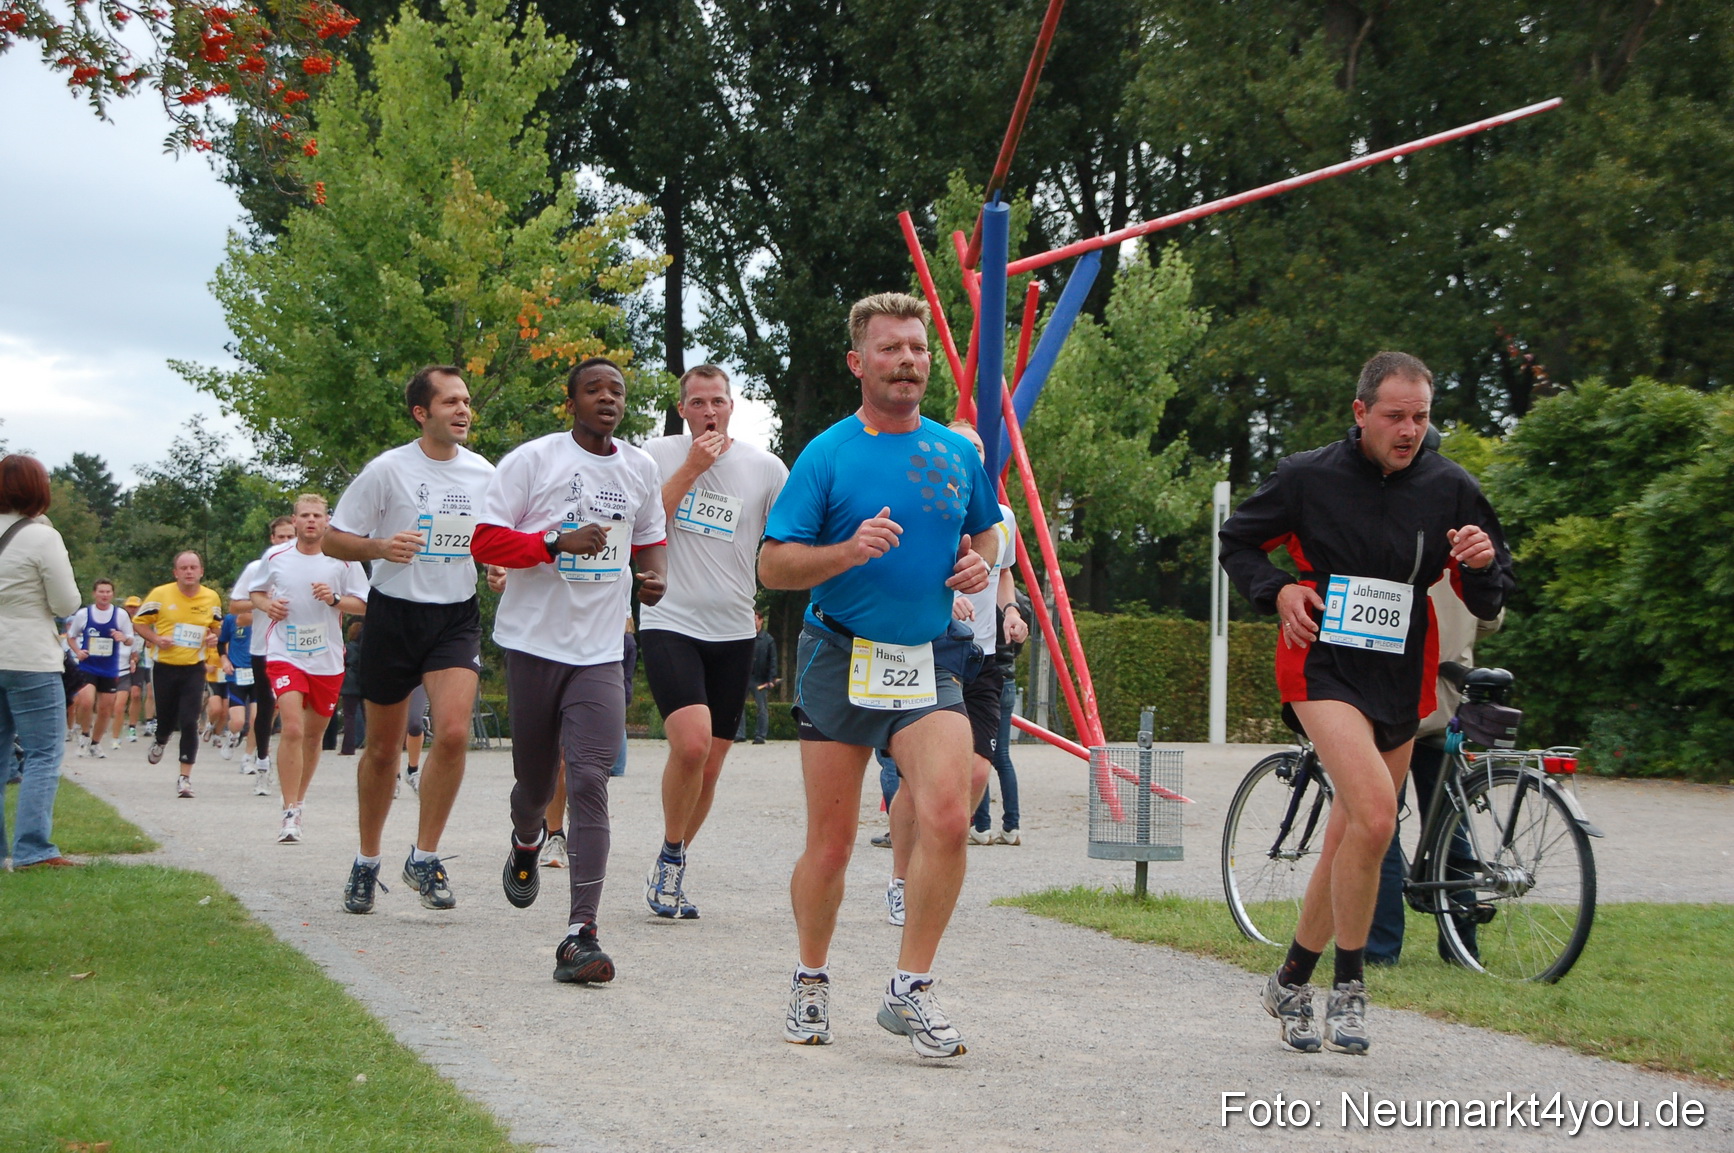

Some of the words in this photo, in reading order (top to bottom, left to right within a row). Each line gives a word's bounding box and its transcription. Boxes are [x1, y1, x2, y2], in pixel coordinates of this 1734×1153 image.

[696, 502, 733, 523] 2678
[434, 533, 470, 548] 3722
[1353, 584, 1402, 602] Johannes
[1350, 603, 1401, 628] 2098
[299, 634, 323, 646] 2661
[875, 647, 906, 663] Hansi
[853, 663, 860, 674] A
[275, 674, 291, 690] 85
[881, 668, 920, 687] 522
